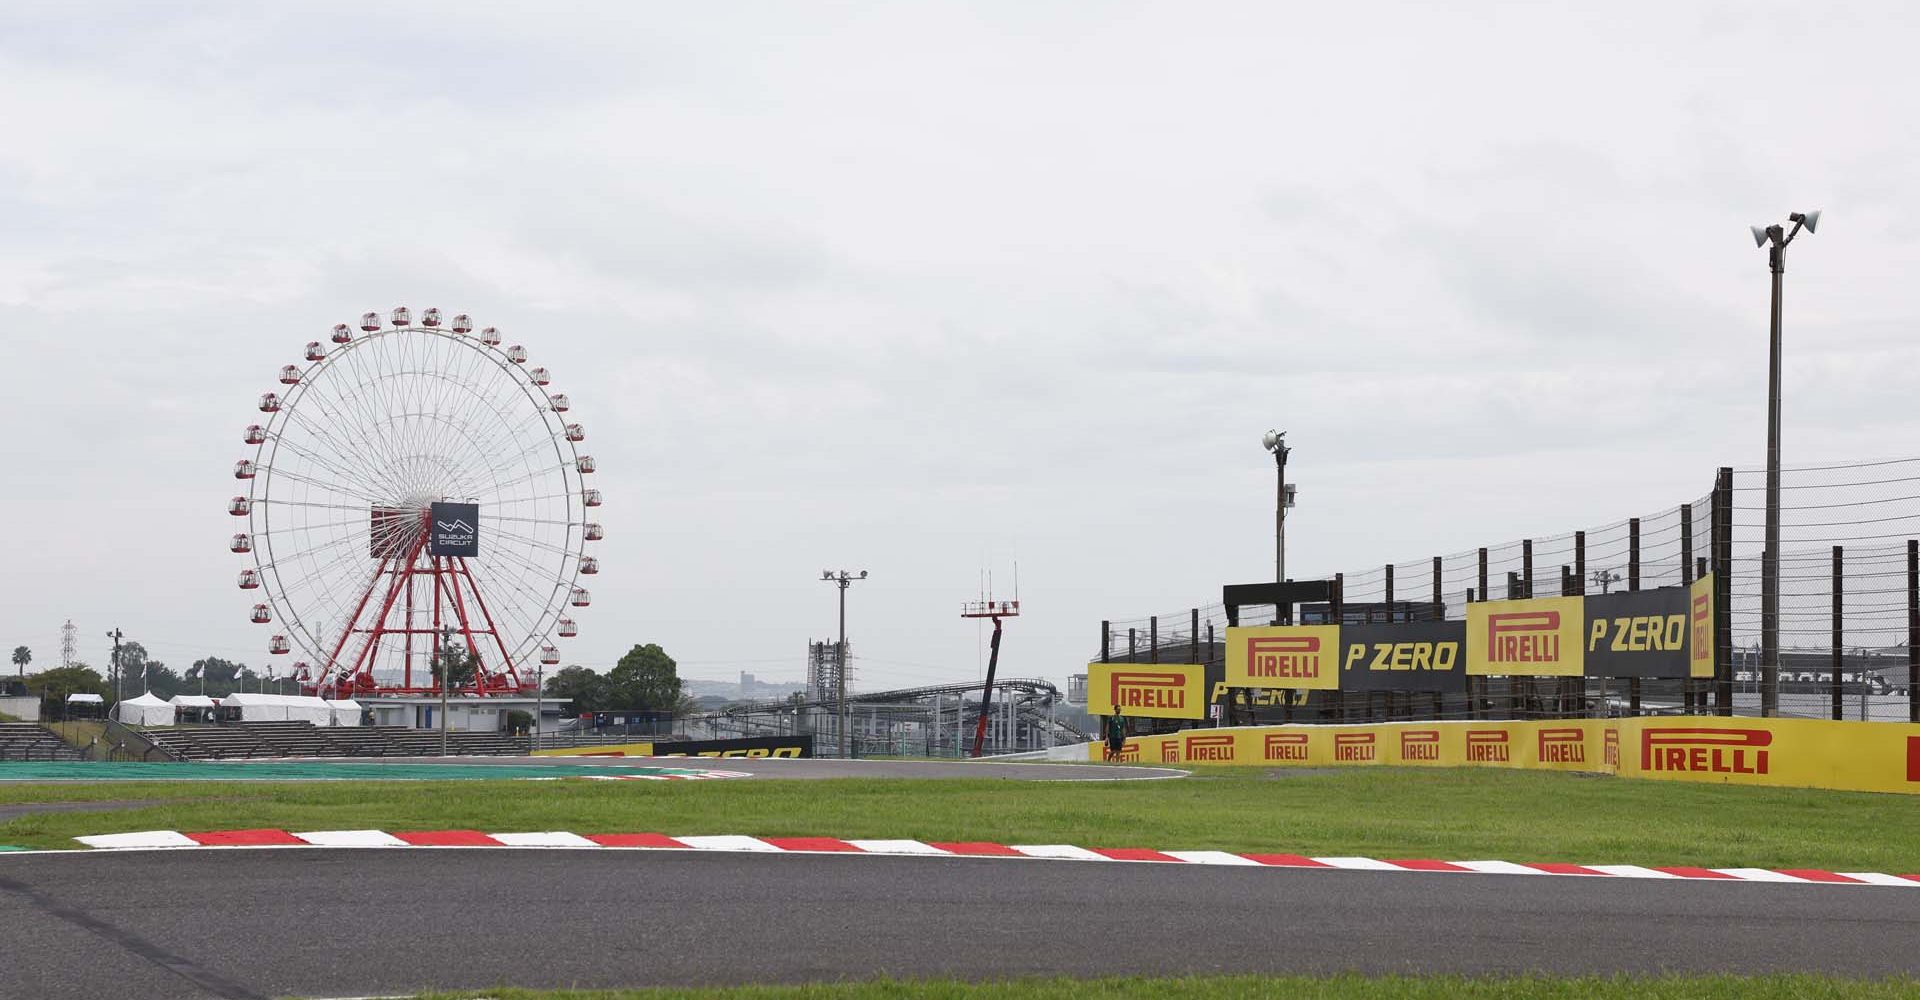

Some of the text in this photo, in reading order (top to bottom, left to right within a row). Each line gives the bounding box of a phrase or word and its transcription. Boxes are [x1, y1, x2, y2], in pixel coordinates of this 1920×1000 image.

[1488, 611, 1560, 662] PIRELLI
[1589, 614, 1686, 652] P ZERO
[1248, 637, 1321, 678] PIRELLI
[1344, 641, 1459, 671] P ZERO
[1111, 672, 1186, 708] PIRELLI
[1186, 735, 1234, 761] PIRELLI
[1265, 733, 1308, 761] PIRELLI
[1335, 732, 1376, 761] PIRELLI
[1401, 730, 1440, 761] PIRELLI
[1466, 730, 1509, 762] PIRELLI
[1538, 728, 1585, 763] PIRELLI
[1641, 728, 1773, 774] PIRELLI
